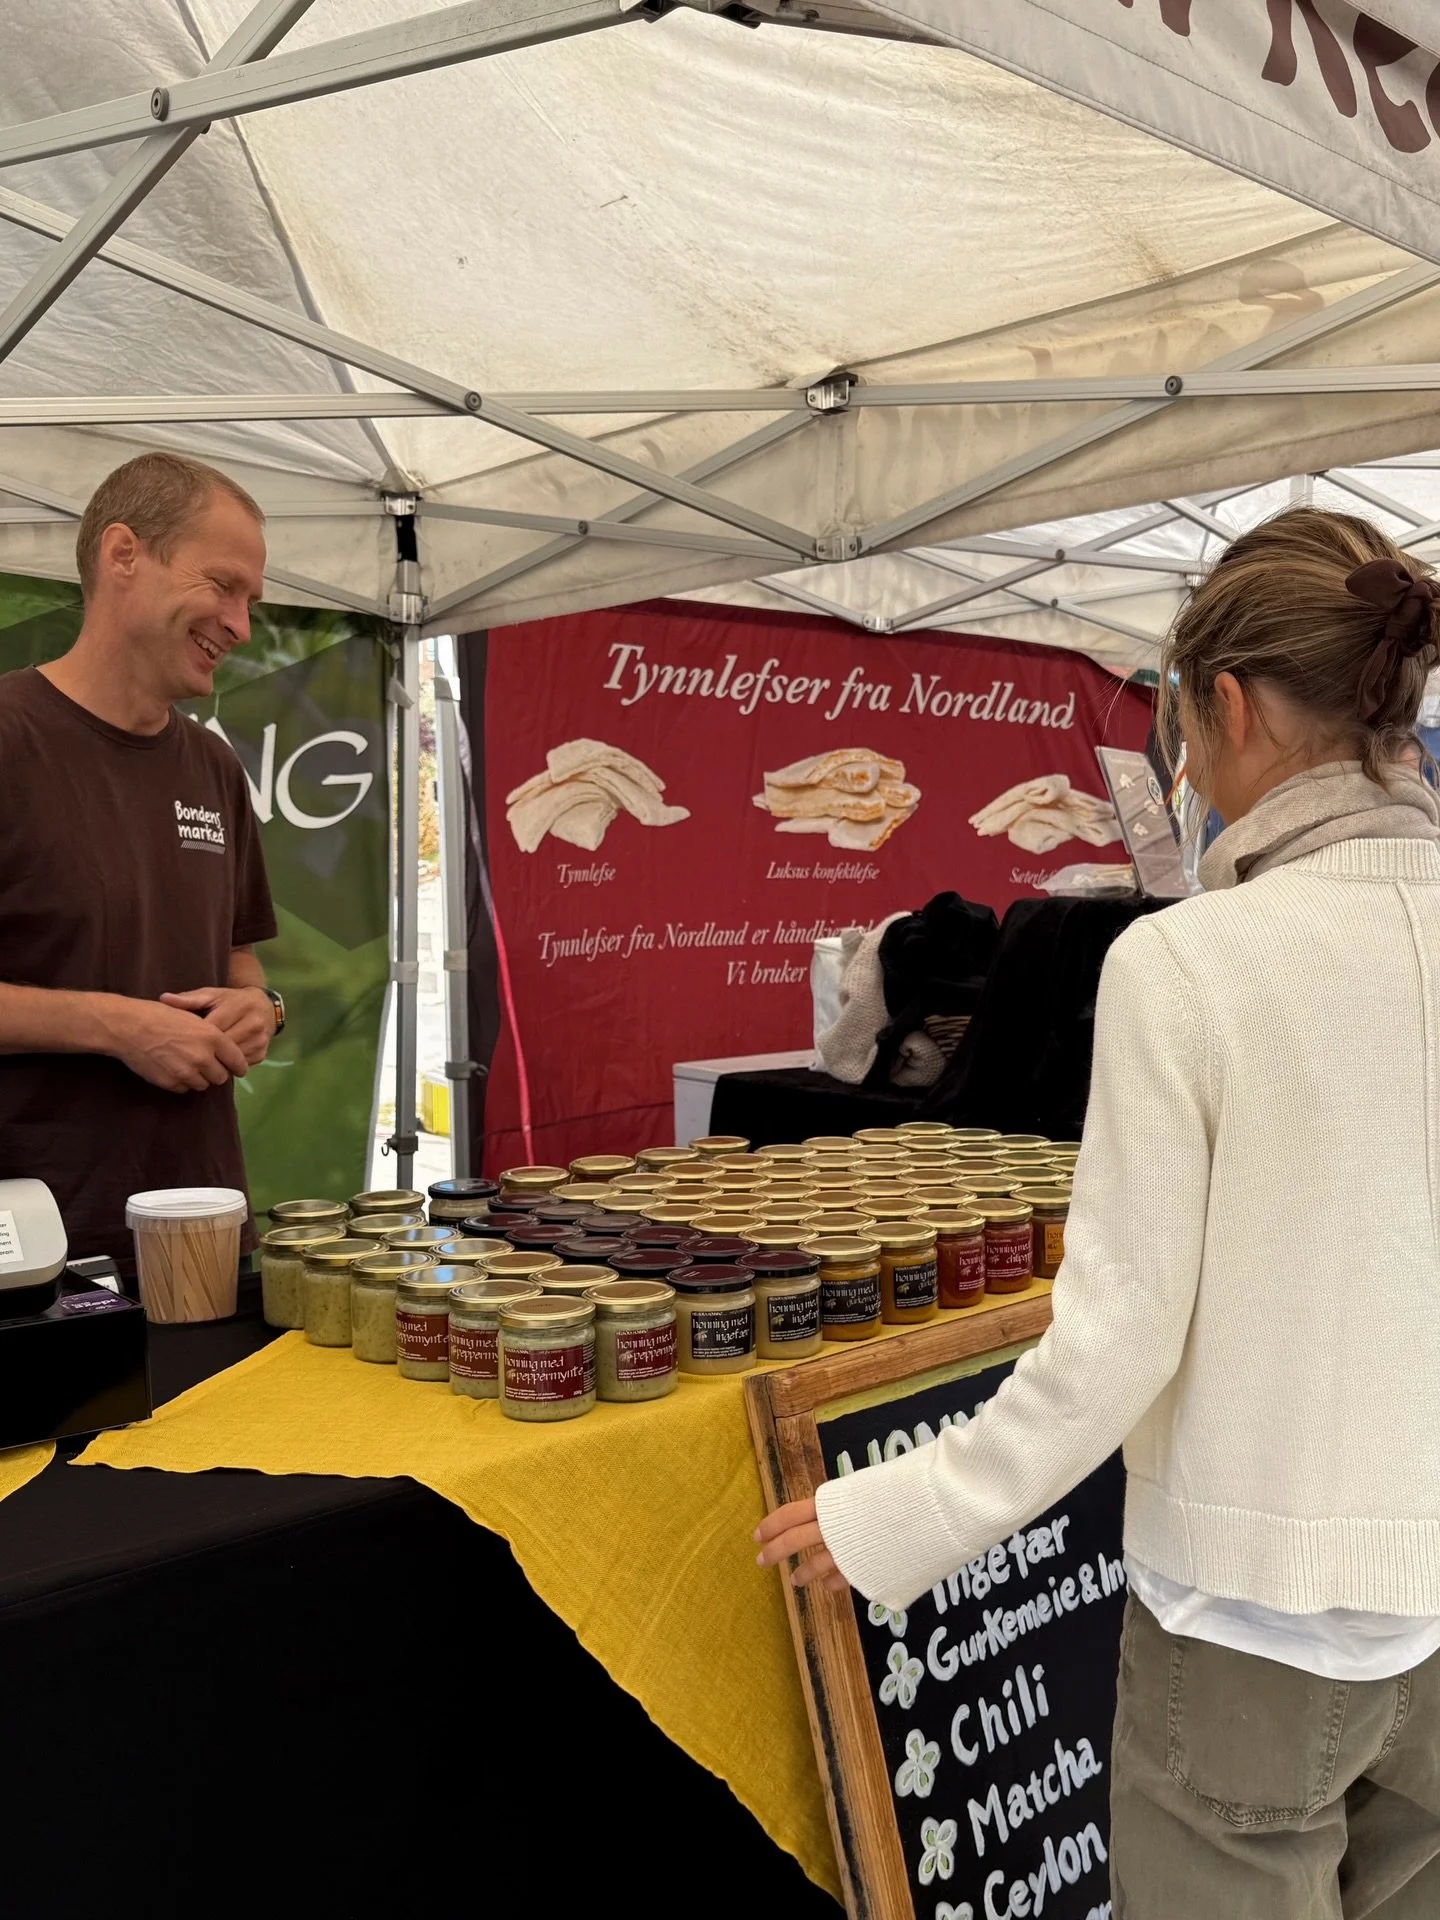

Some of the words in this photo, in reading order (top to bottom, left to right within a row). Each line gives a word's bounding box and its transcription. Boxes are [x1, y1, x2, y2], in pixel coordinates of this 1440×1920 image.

[603, 643, 831, 715] Tynnlefser
[824, 667, 890, 720] fra
[900, 673, 1076, 730] Nordland
[188, 713, 373, 829] NG
[174, 800, 221, 829] Bondens
[177, 823, 225, 845] marked
[557, 862, 616, 889] Tynnlefse
[766, 861, 809, 880] Luksus
[812, 862, 881, 884] konfektlefse
[538, 927, 624, 967] Tynnlefser
[621, 924, 655, 959] fra
[658, 921, 749, 949] Nordland
[752, 928, 769, 945] er
[726, 961, 747, 986] Vi
[751, 959, 808, 985] bruker
[505, 1354, 538, 1371] honning
[540, 1355, 564, 1369] med
[516, 1366, 584, 1385] peppermynte
[951, 1664, 1049, 1766] Chili
[967, 1737, 1102, 1857] Matcha
[984, 1822, 1107, 1920] Ceylon
